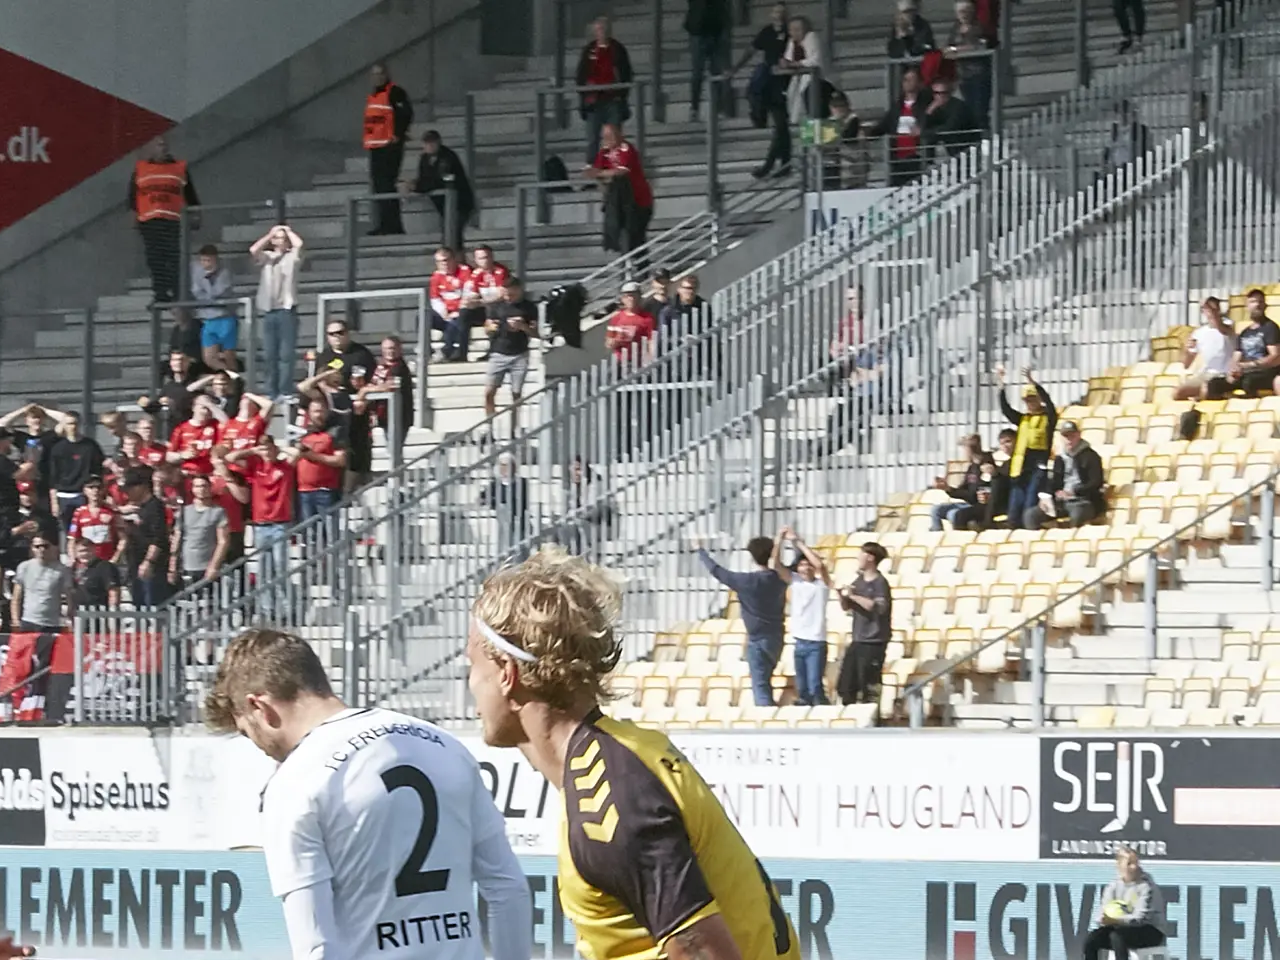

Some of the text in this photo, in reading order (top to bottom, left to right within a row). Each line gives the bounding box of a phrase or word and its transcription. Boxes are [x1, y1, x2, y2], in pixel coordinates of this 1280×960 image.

[50, 771, 170, 820] Spisehus
[708, 784, 801, 828] NTIN
[836, 784, 1033, 829] HAUGLAND
[380, 764, 452, 898] 2
[376, 911, 472, 950] RITTER
